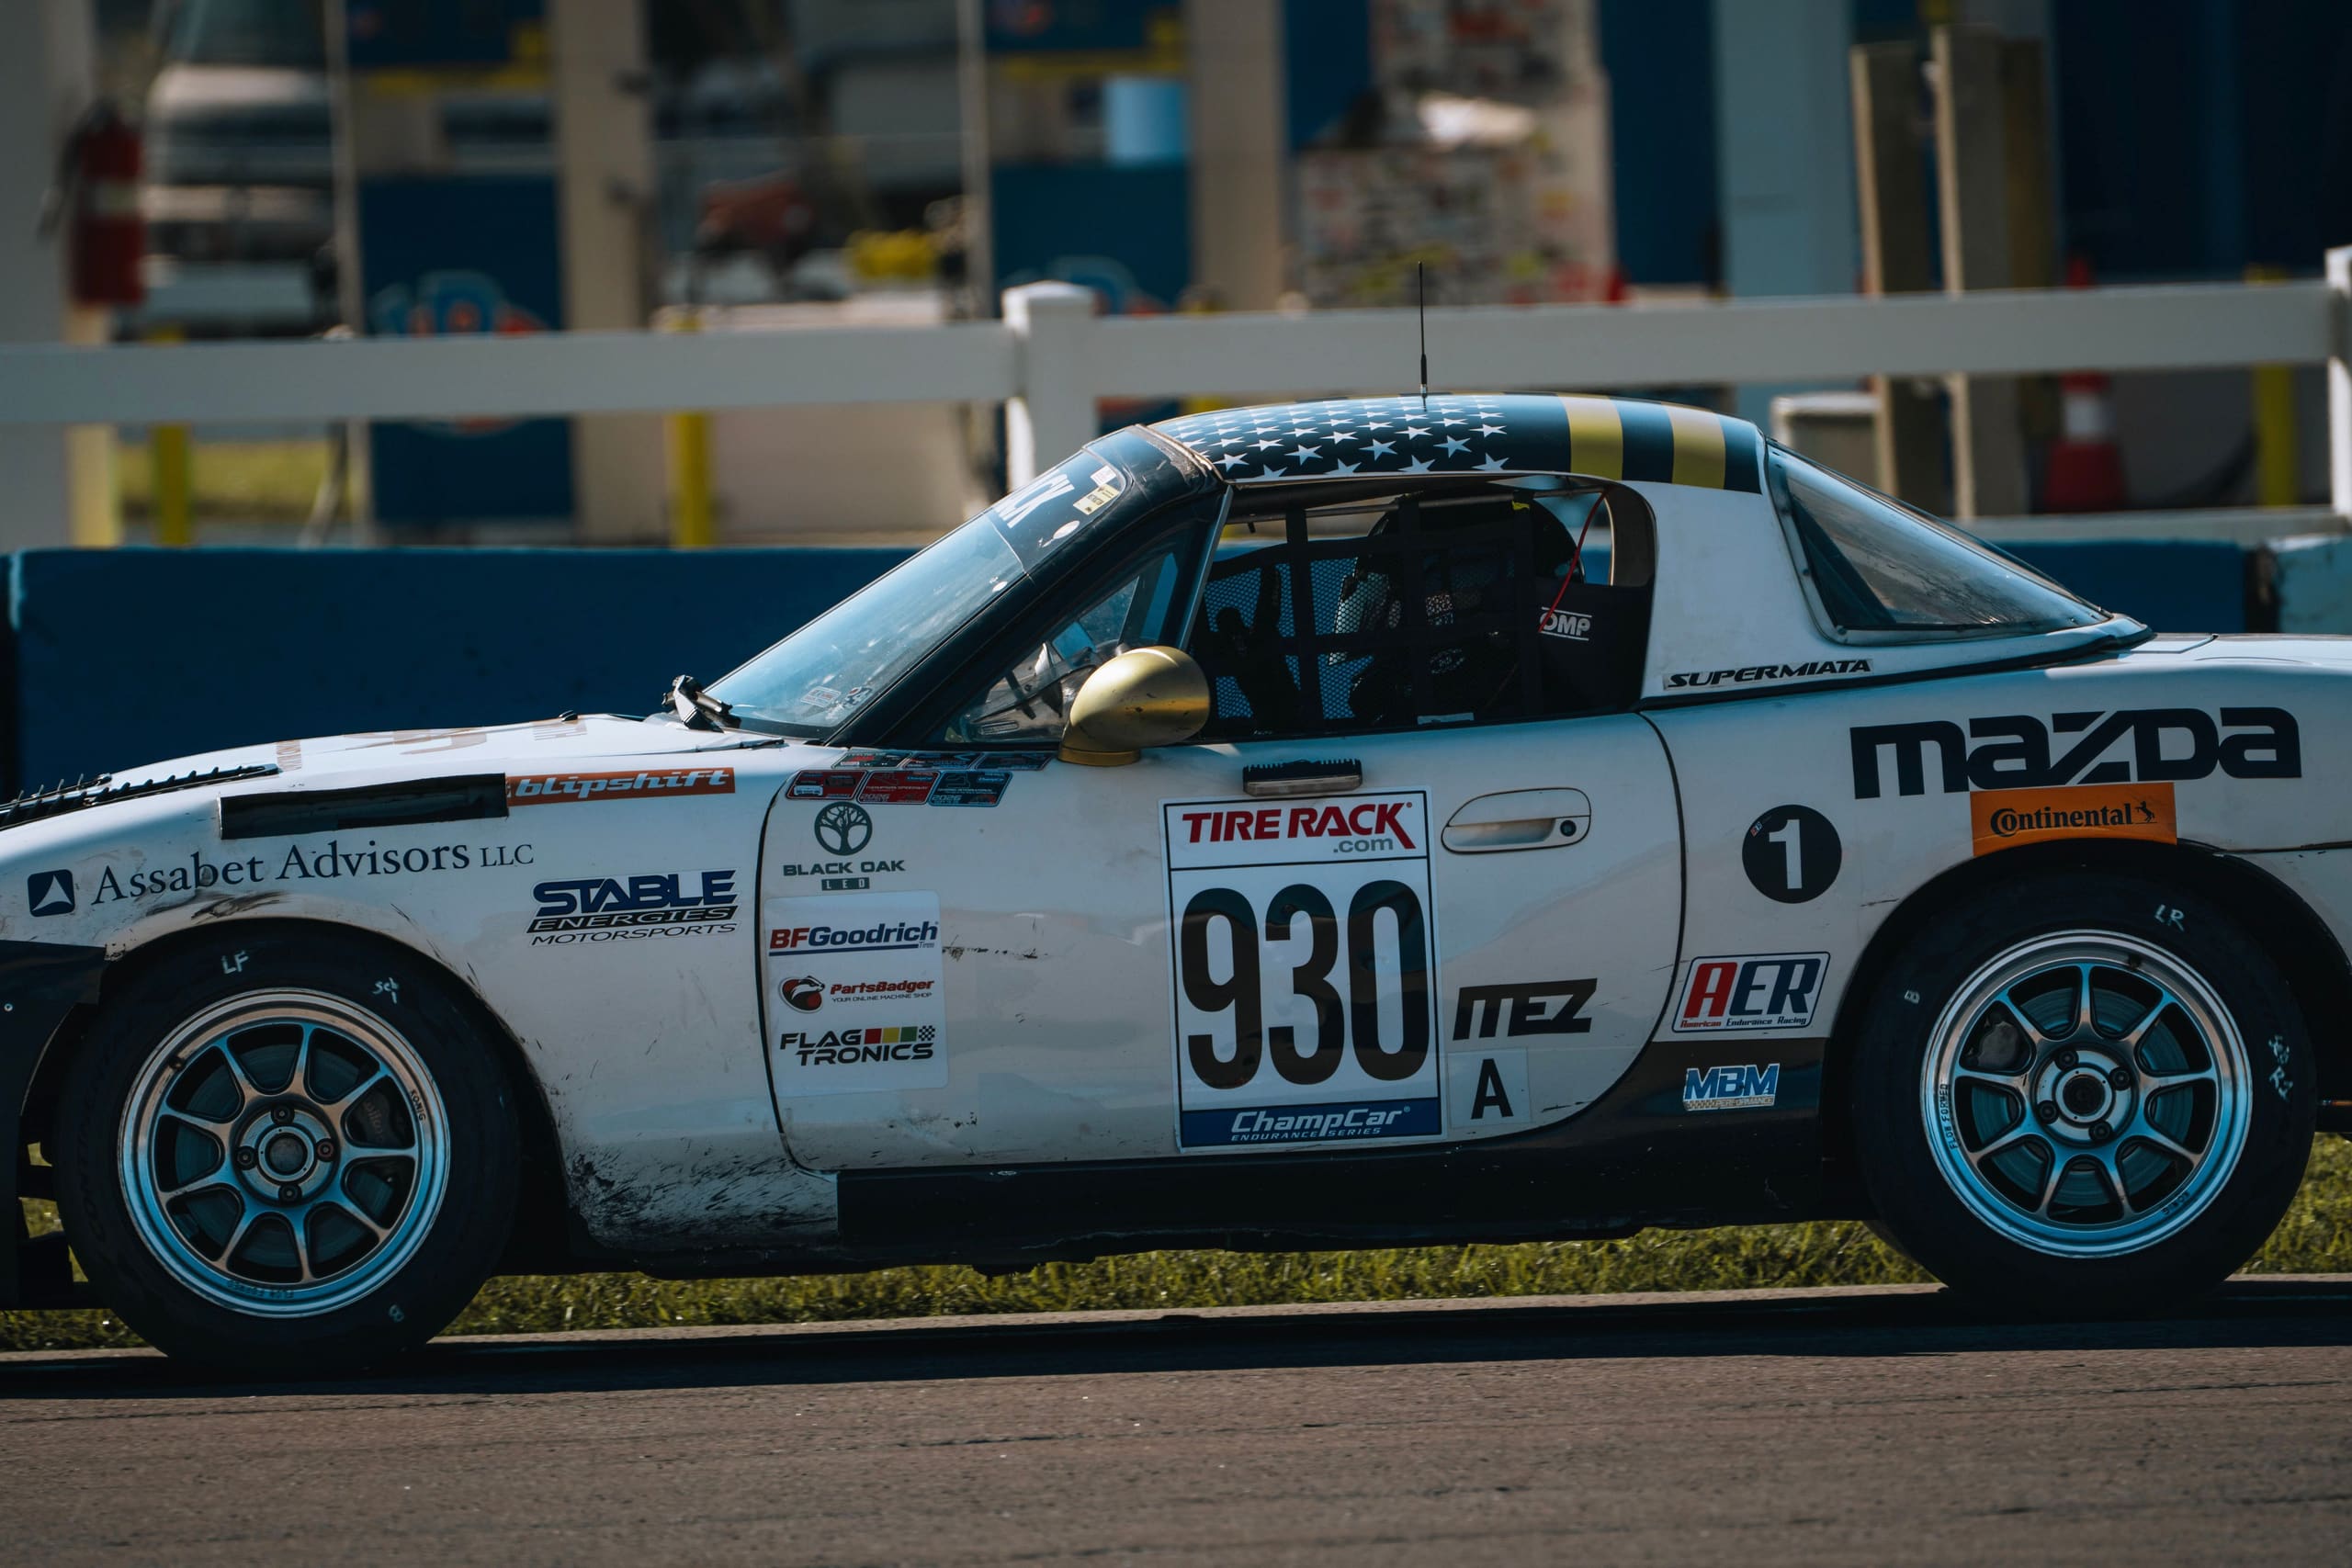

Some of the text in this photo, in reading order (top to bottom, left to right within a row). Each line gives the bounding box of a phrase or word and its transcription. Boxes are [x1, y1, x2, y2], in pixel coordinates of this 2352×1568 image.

[1540, 612, 1591, 637] OMP
[1668, 660, 1871, 688] SUPERMIATA
[515, 770, 729, 798] blipshift
[1182, 803, 1417, 850] TIRE RACK
[1990, 803, 2133, 838] Continental
[1333, 837, 1394, 853] .com
[1769, 818, 1802, 889] 1
[92, 840, 535, 905] Assabet Advisors LLC
[783, 860, 906, 876] BLACK OAK
[533, 870, 738, 917] STABLE
[825, 879, 865, 889] LED
[533, 908, 732, 931] ENERGIES
[2154, 904, 2185, 932] LR
[531, 923, 738, 945] MOTORSPORTS
[770, 921, 938, 949] BFGoodrich
[220, 951, 250, 974] LF
[831, 980, 935, 995] PartsBadger
[1181, 879, 1430, 1089] 930
[1683, 958, 1821, 1018] AER
[1680, 1016, 1807, 1029] American Endurance Racing
[780, 1029, 863, 1050] FLAG
[796, 1043, 934, 1066] TRONICS
[1471, 1058, 1513, 1119] A
[1684, 1064, 1780, 1100] MBM
[1231, 1109, 1402, 1137] ChampCar
[1231, 1128, 1382, 1142] ENDURANCE SERIES
